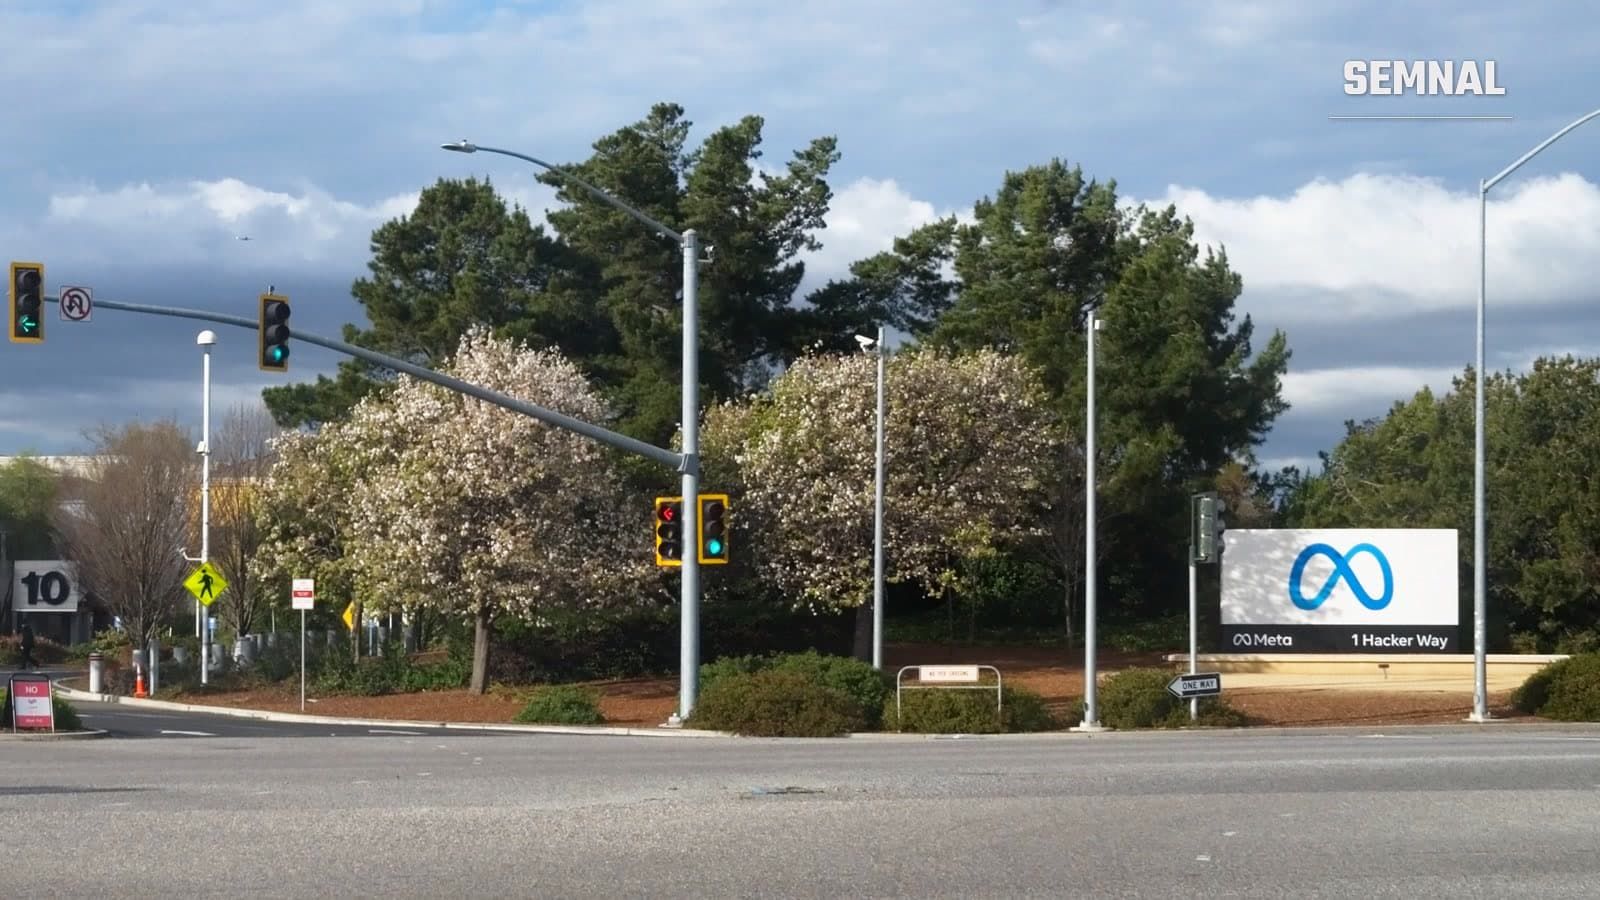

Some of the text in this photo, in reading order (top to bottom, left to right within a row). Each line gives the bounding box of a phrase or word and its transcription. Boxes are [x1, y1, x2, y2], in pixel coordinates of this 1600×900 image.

[21, 571, 70, 606] 10
[1254, 633, 1293, 646] Meta
[1351, 633, 1448, 649] 1 Hacker Way
[25, 685, 39, 694] NO
[1182, 680, 1214, 690] ONE WAY
